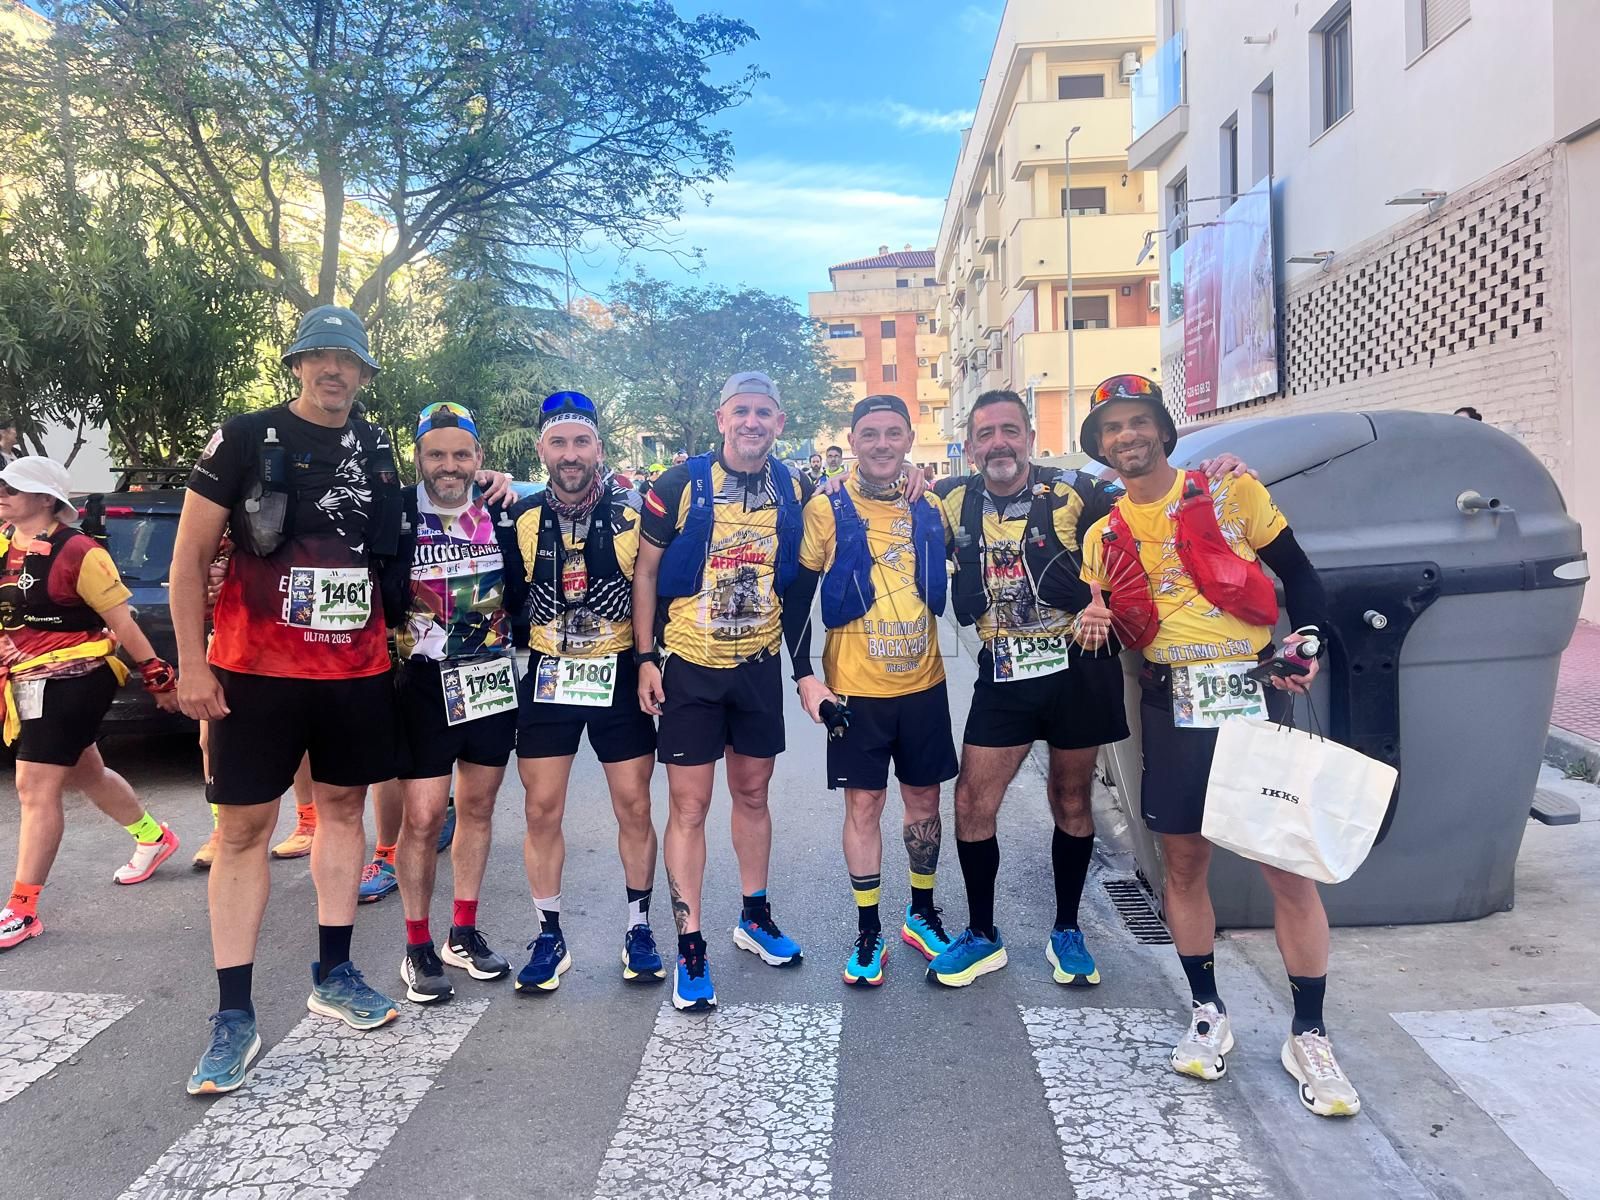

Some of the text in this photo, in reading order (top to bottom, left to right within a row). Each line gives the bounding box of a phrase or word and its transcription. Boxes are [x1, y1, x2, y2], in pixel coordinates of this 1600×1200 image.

[321, 582, 366, 604] 1461
[303, 631, 352, 644] ULTRA 2025
[467, 669, 511, 696] 1794
[565, 662, 612, 684] 1180
[1197, 673, 1258, 699] 1095
[1261, 787, 1299, 804] IKKS
